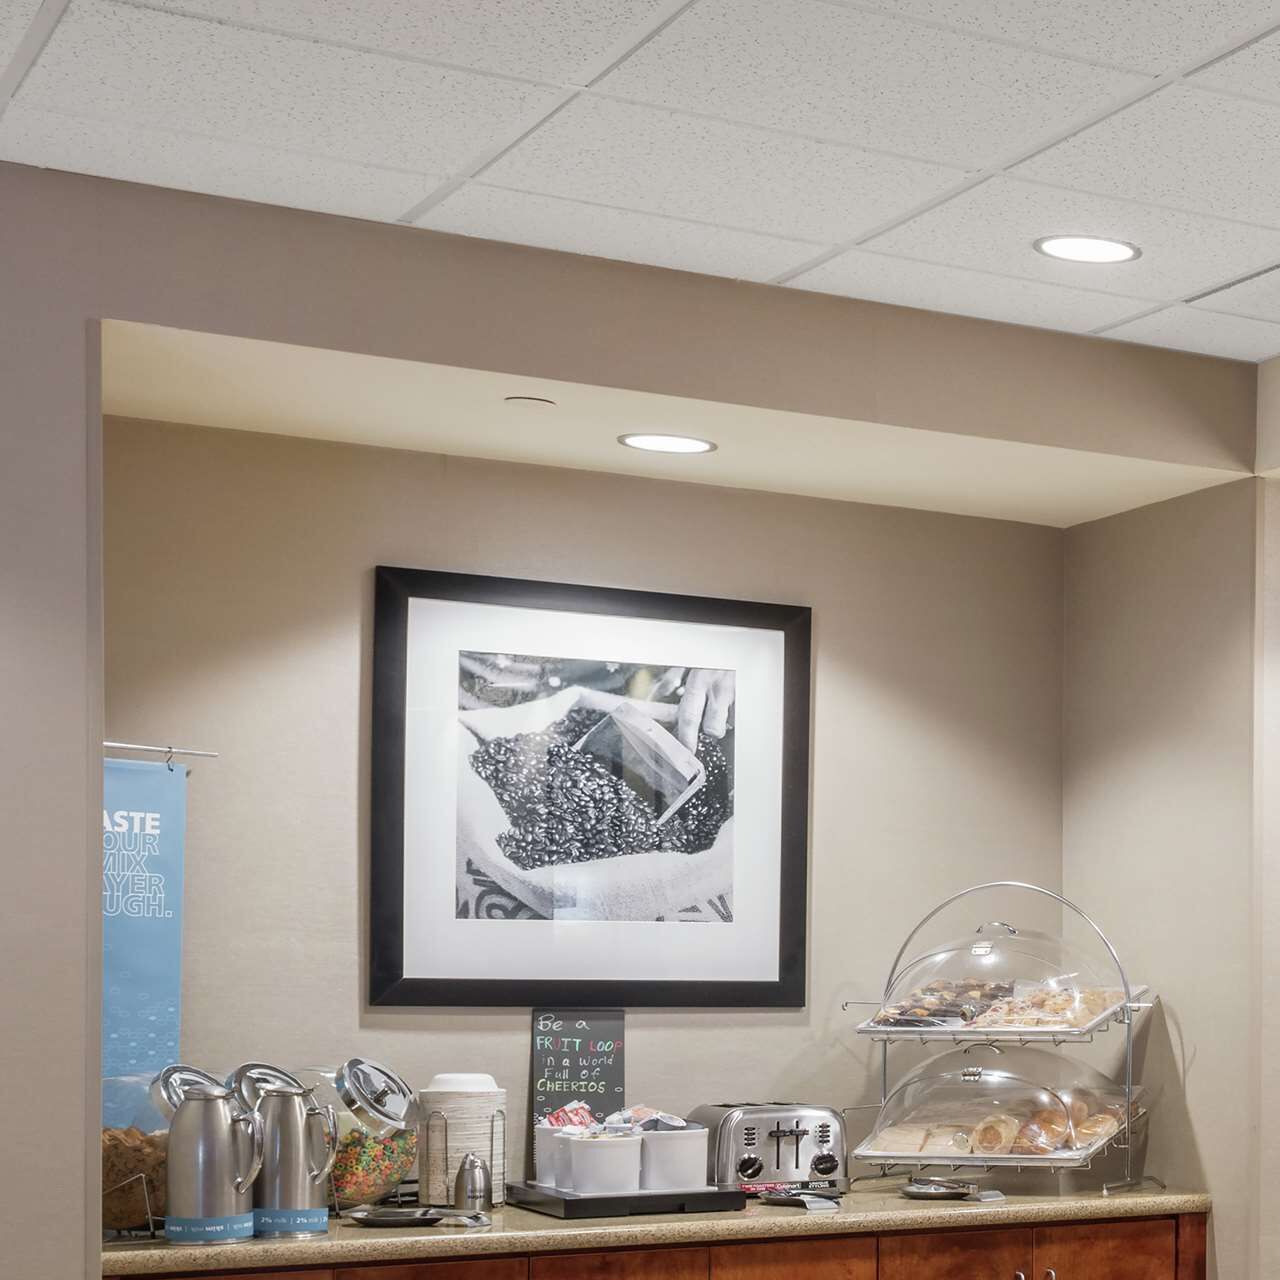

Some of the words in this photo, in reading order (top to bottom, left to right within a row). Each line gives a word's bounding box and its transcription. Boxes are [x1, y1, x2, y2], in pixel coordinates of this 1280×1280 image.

[103, 810, 160, 833] ASTE
[537, 1014, 563, 1031] Be
[575, 1020, 590, 1030] a
[536, 1036, 581, 1052] FRUIT
[589, 1039, 623, 1053] LOOP
[542, 1055, 555, 1066] in
[562, 1058, 570, 1067] a
[580, 1068, 601, 1079] of
[537, 1079, 606, 1093] CHEERIOS
